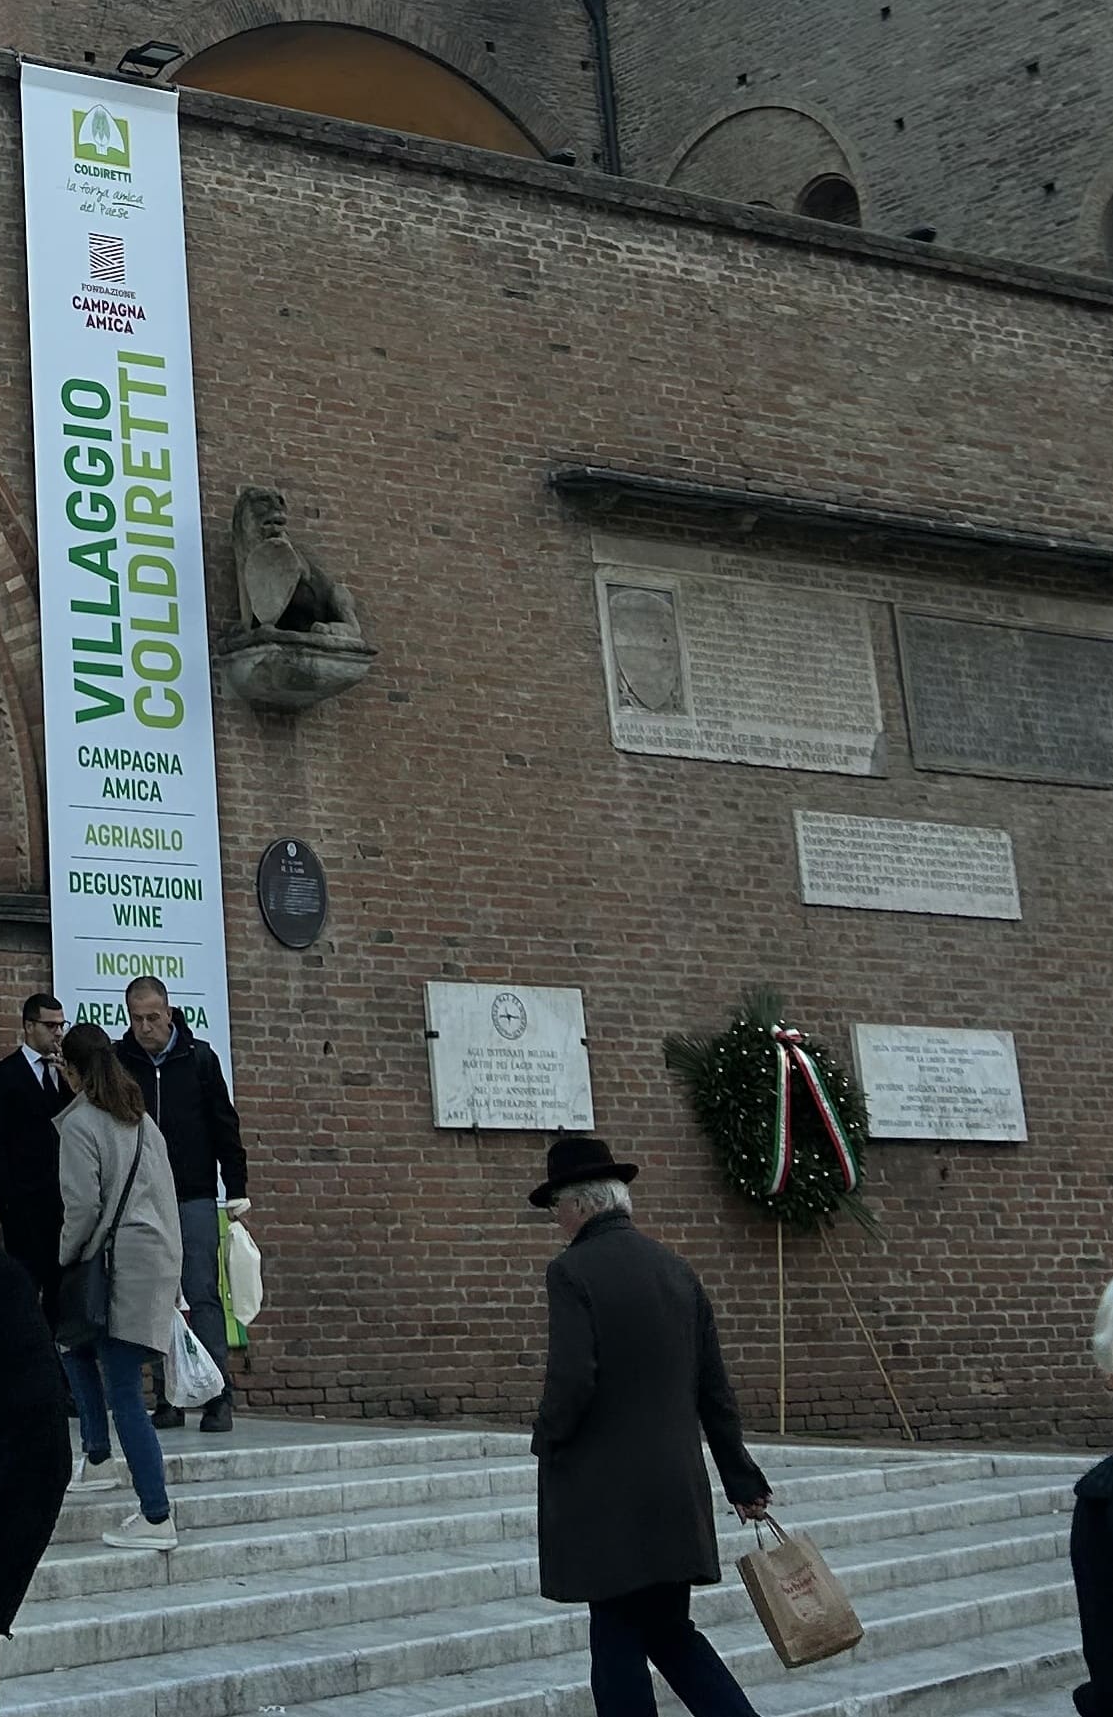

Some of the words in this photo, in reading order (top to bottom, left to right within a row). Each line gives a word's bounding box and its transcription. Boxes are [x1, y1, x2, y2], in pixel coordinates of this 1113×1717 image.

[74, 163, 132, 183] COLDIRETTI
[79, 182, 109, 202] forza
[112, 190, 144, 204] amica
[79, 202, 95, 213] del
[100, 204, 130, 219] Paese
[81, 283, 136, 300] FONDAZIONE
[72, 296, 146, 321] CAMPAGNA
[86, 314, 134, 334] AMICA
[60, 377, 126, 724] VILLAGGIO
[117, 350, 184, 729] COLDIRETTI
[78, 746, 183, 775] CAMPAGNA
[102, 776, 162, 802] AMICA
[85, 823, 183, 851] AGRIASILO
[69, 871, 202, 901] DEGUSTAZIONI
[113, 903, 163, 928] WINE
[96, 952, 184, 978] INCONTRI
[76, 1002, 128, 1026] AREA
